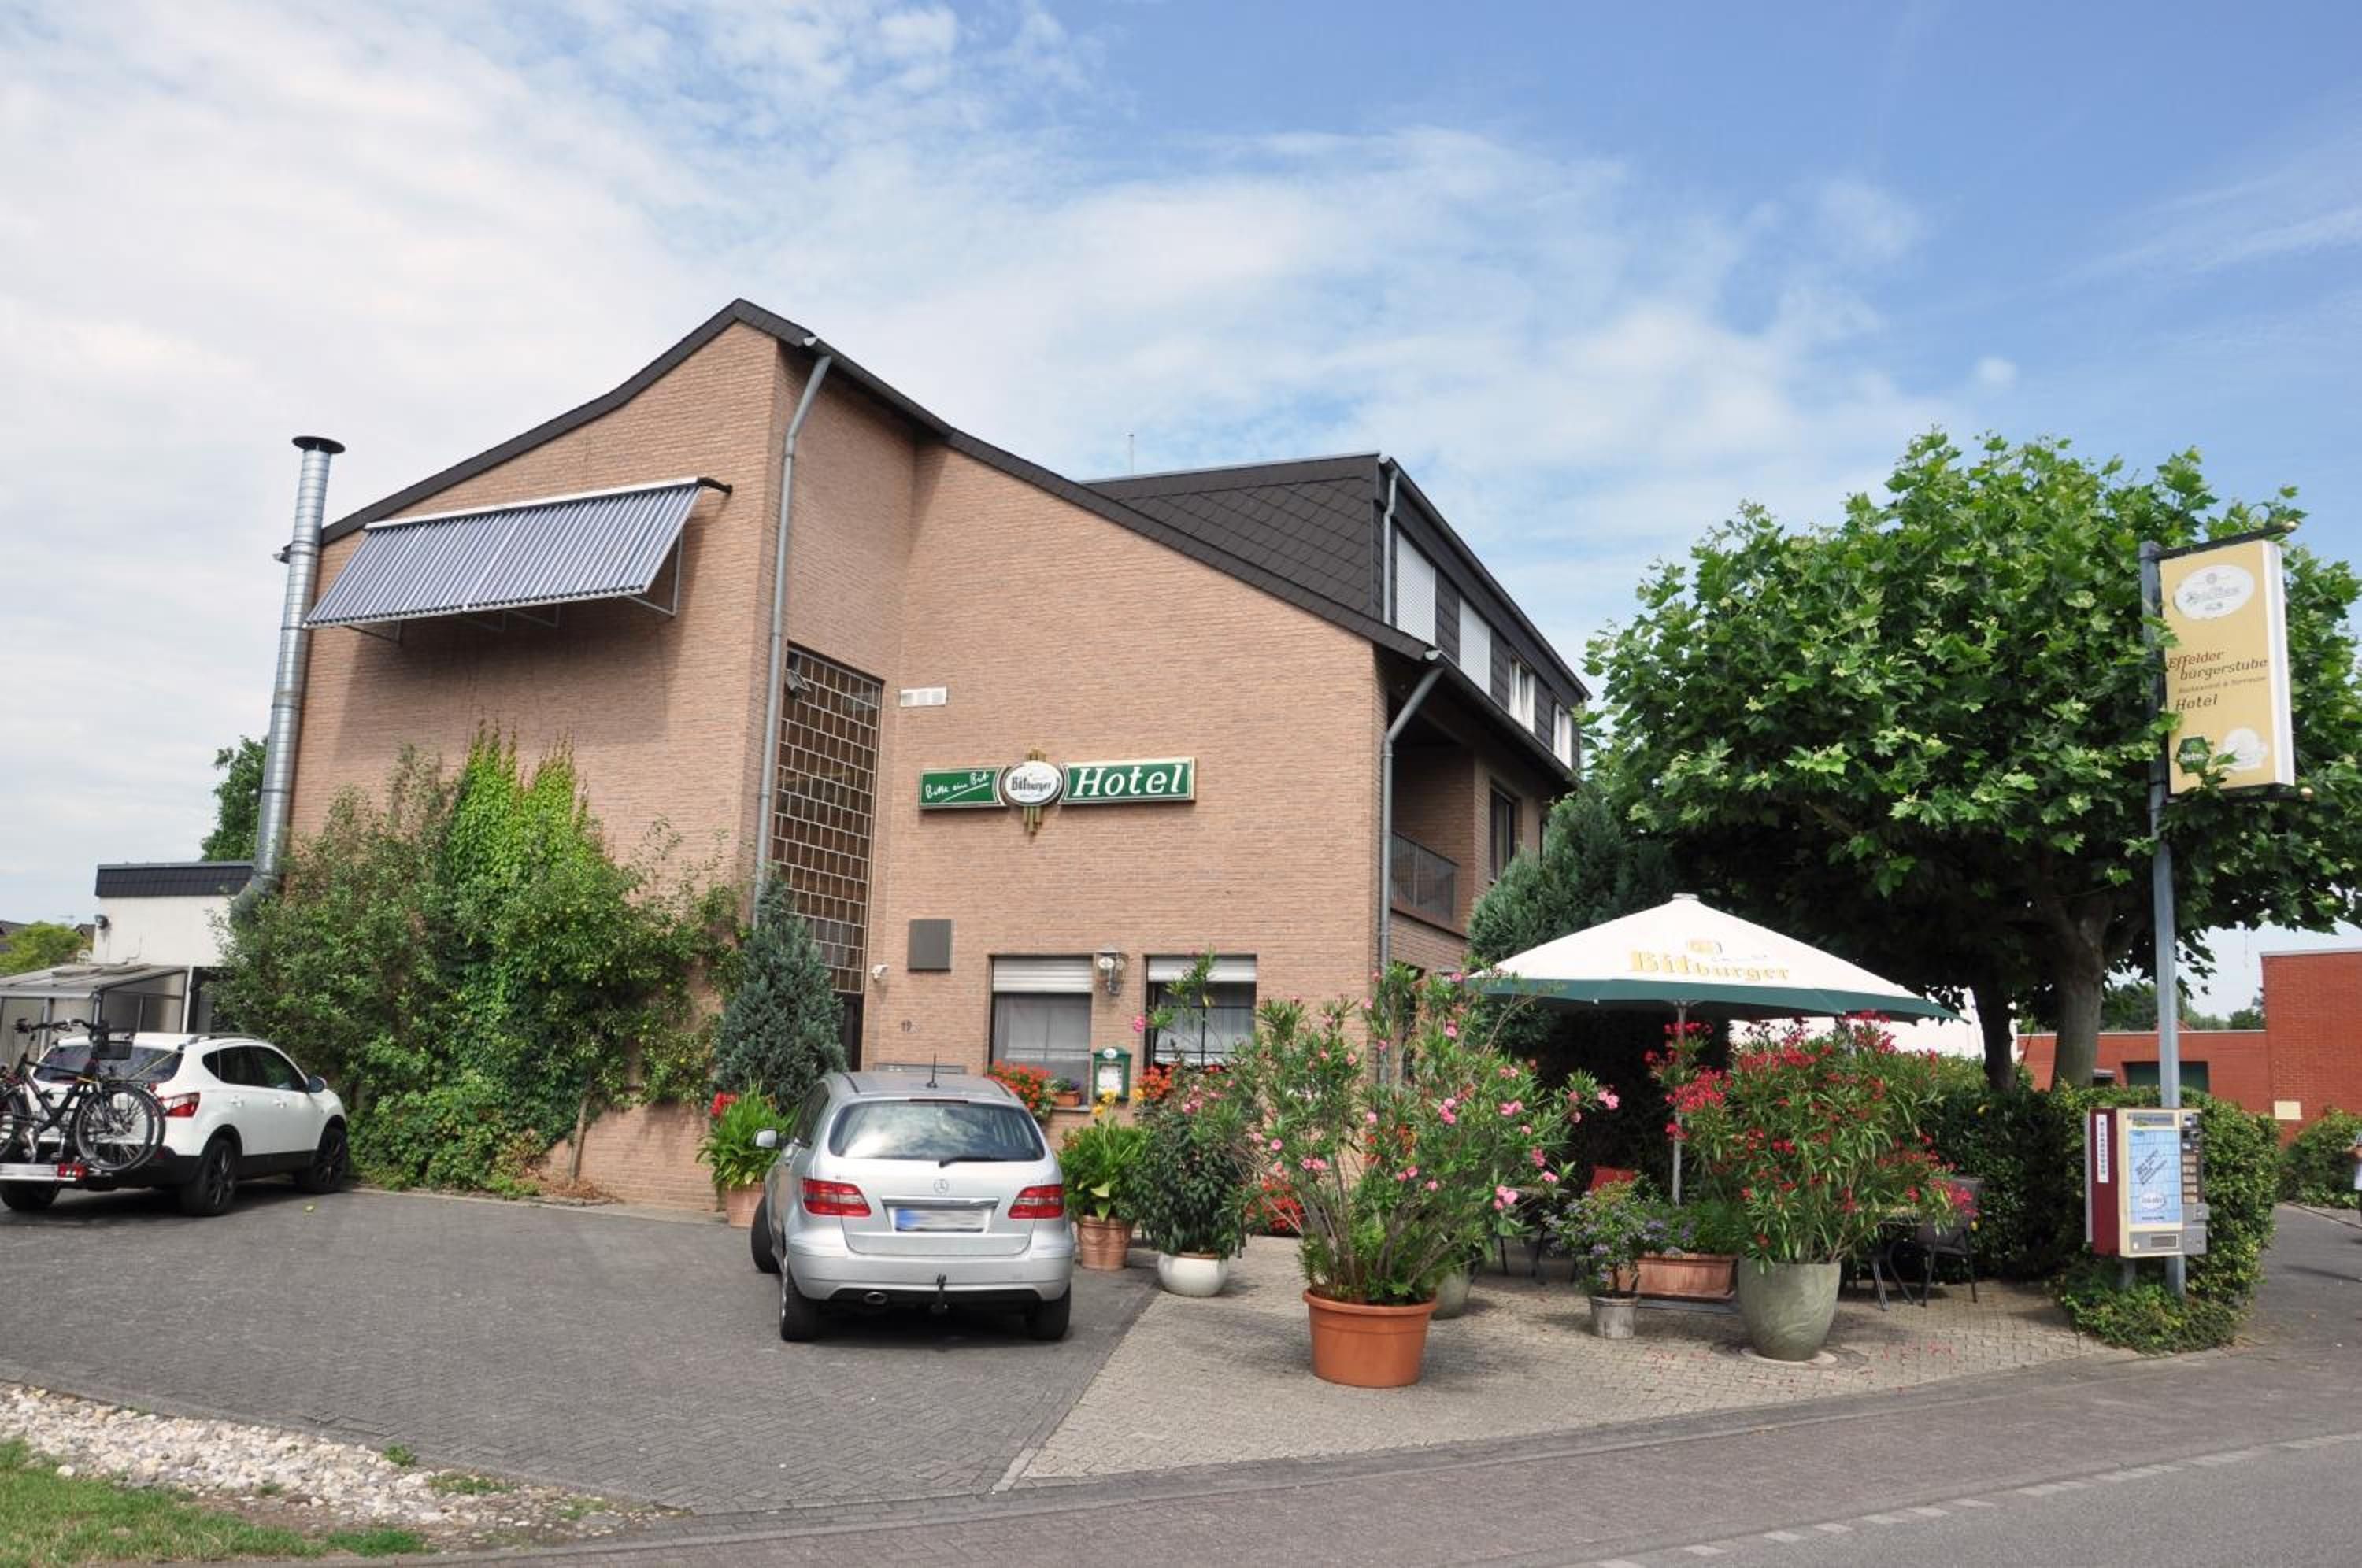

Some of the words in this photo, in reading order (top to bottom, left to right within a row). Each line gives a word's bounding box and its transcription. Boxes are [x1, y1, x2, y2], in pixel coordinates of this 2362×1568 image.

[2168, 651, 2224, 671] Effelder
[2175, 693, 2218, 711] Hotel
[925, 782, 949, 799] Bitte
[969, 771, 990, 785] Bit
[1011, 775, 1052, 793] Bitburger
[1072, 764, 1183, 797] Hotel
[1631, 950, 1790, 982] Bitburger
